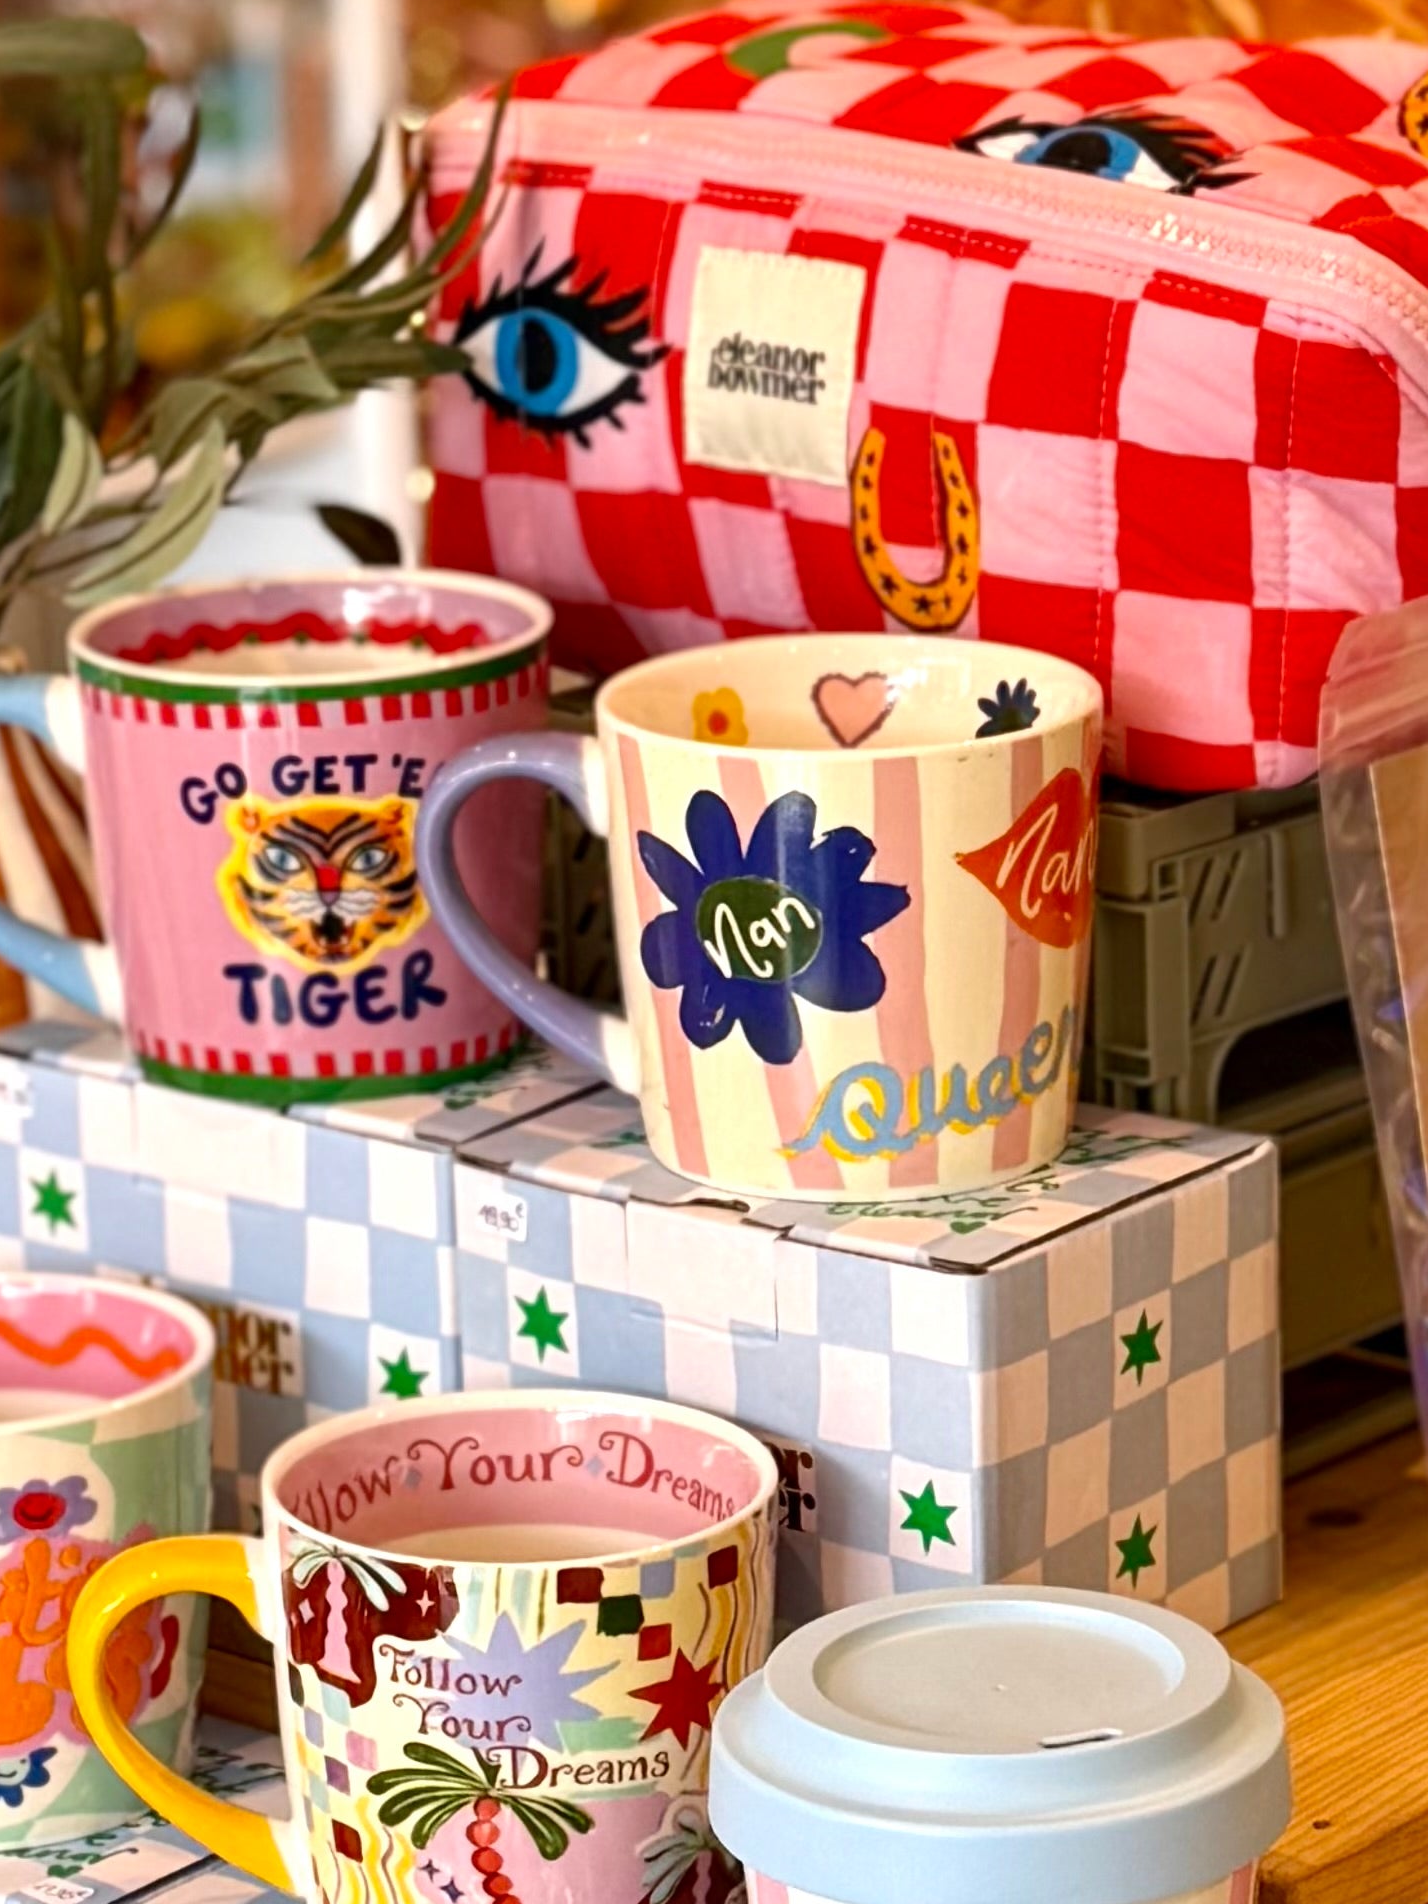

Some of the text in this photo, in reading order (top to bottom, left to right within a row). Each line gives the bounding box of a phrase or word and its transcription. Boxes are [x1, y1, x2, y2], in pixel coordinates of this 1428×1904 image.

[707, 348, 825, 405] bowmer
[717, 330, 825, 379] eleanor
[180, 753, 444, 824] GO GET 'E
[704, 895, 815, 979] Nan
[223, 948, 448, 1027] TIGER
[408, 1435, 584, 1492] Your
[378, 1643, 522, 1697] Follow
[392, 1693, 532, 1742] Your
[486, 1746, 670, 1789] Dreams
